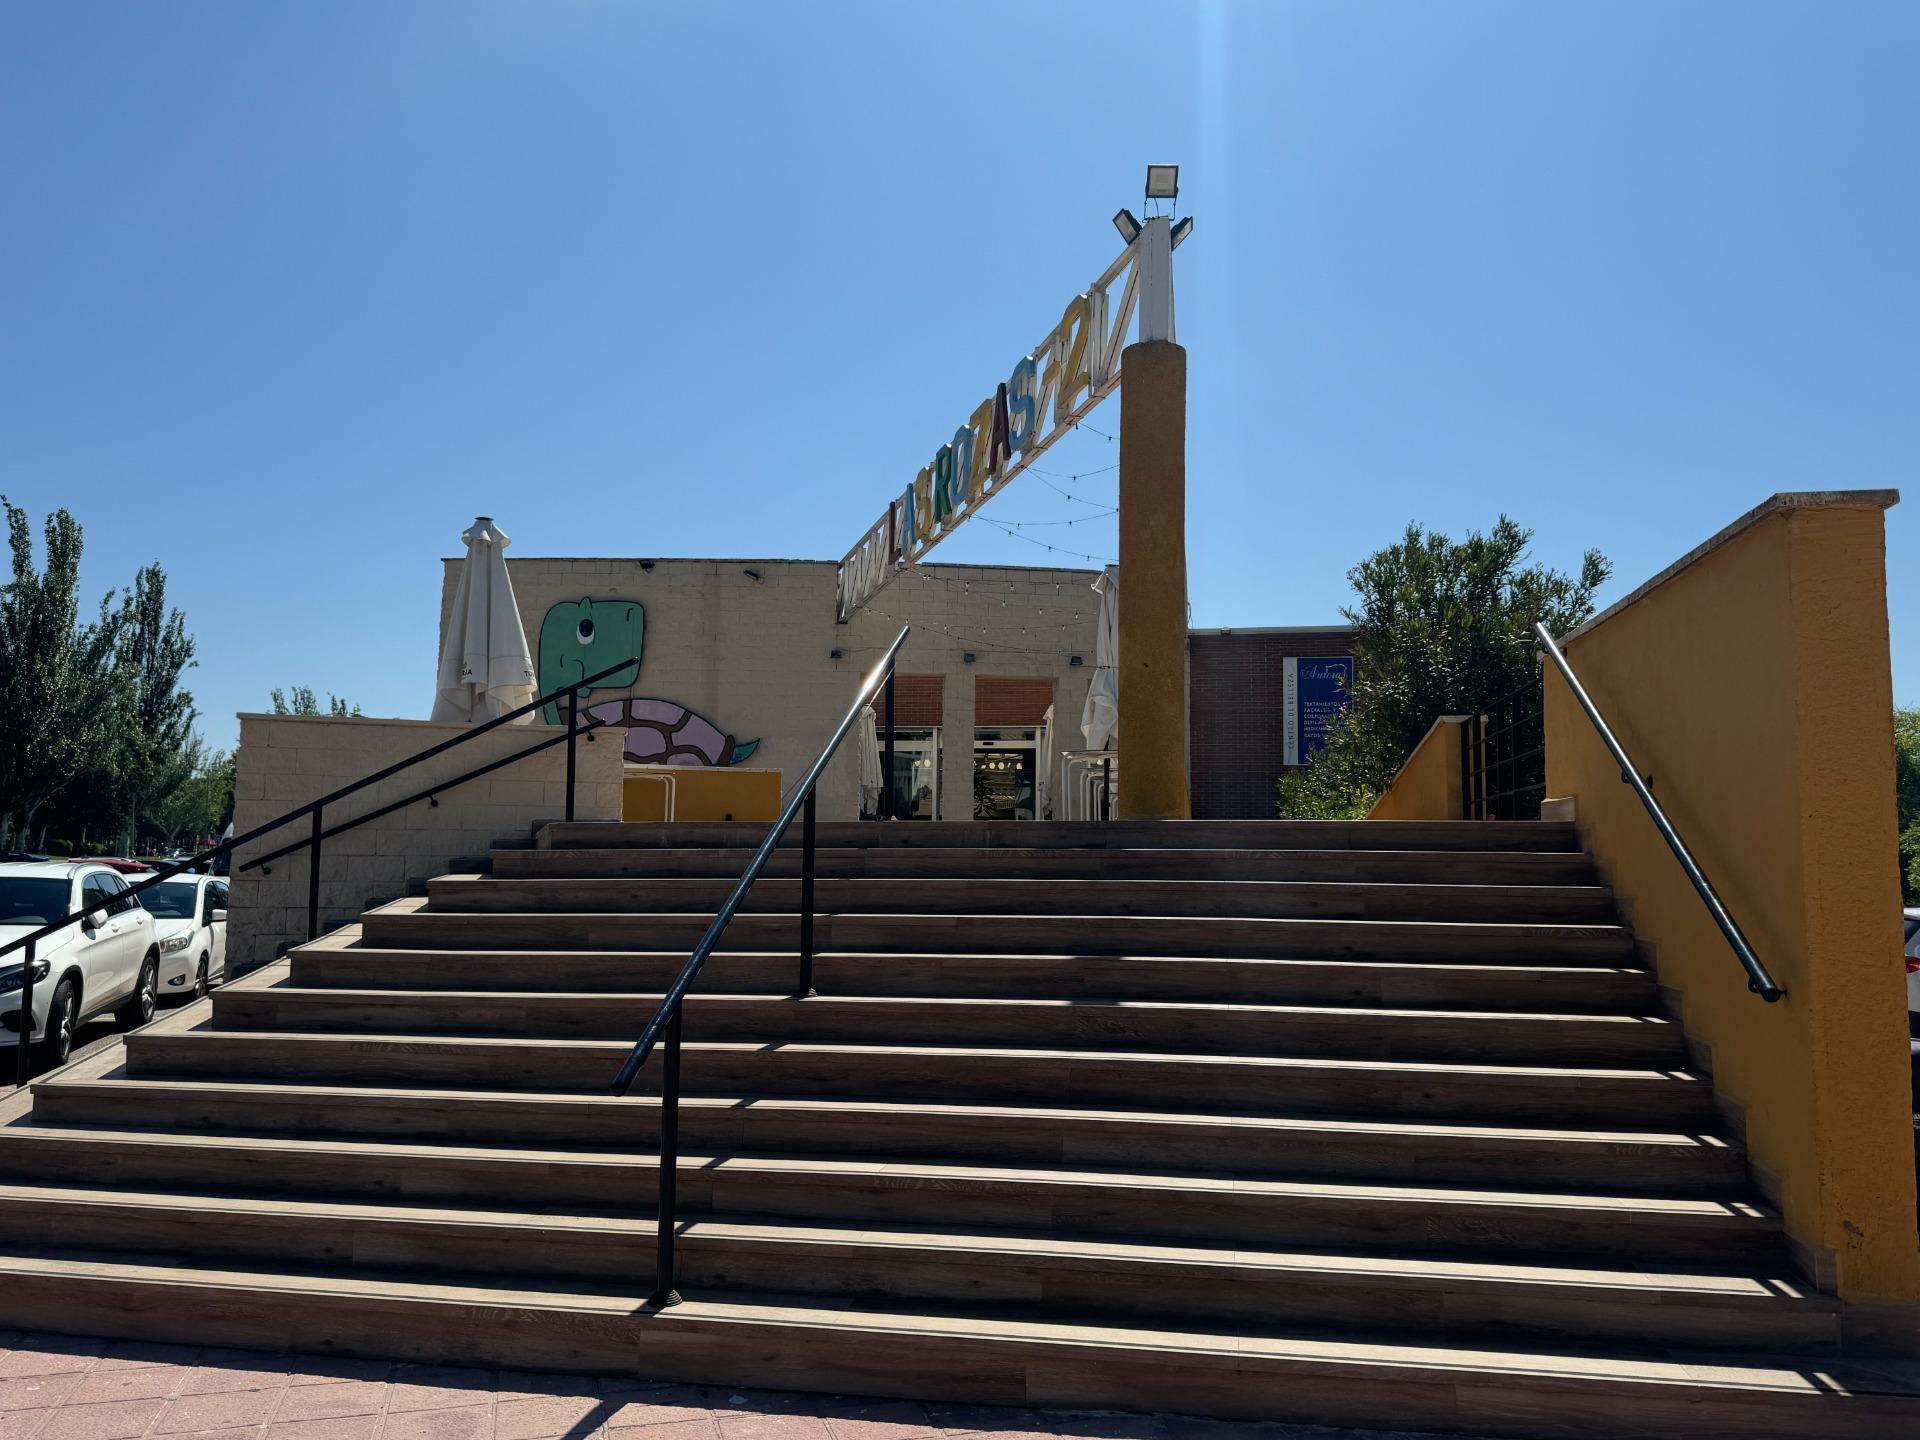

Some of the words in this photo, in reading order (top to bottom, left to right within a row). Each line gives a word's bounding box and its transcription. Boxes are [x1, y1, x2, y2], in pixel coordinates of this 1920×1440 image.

[888, 467, 933, 565] LAS
[1303, 664, 1342, 680] Aurora
[1287, 673, 1295, 705] BELLEZA
[1287, 708, 1295, 717] DE
[1287, 720, 1295, 750] CENTRO
